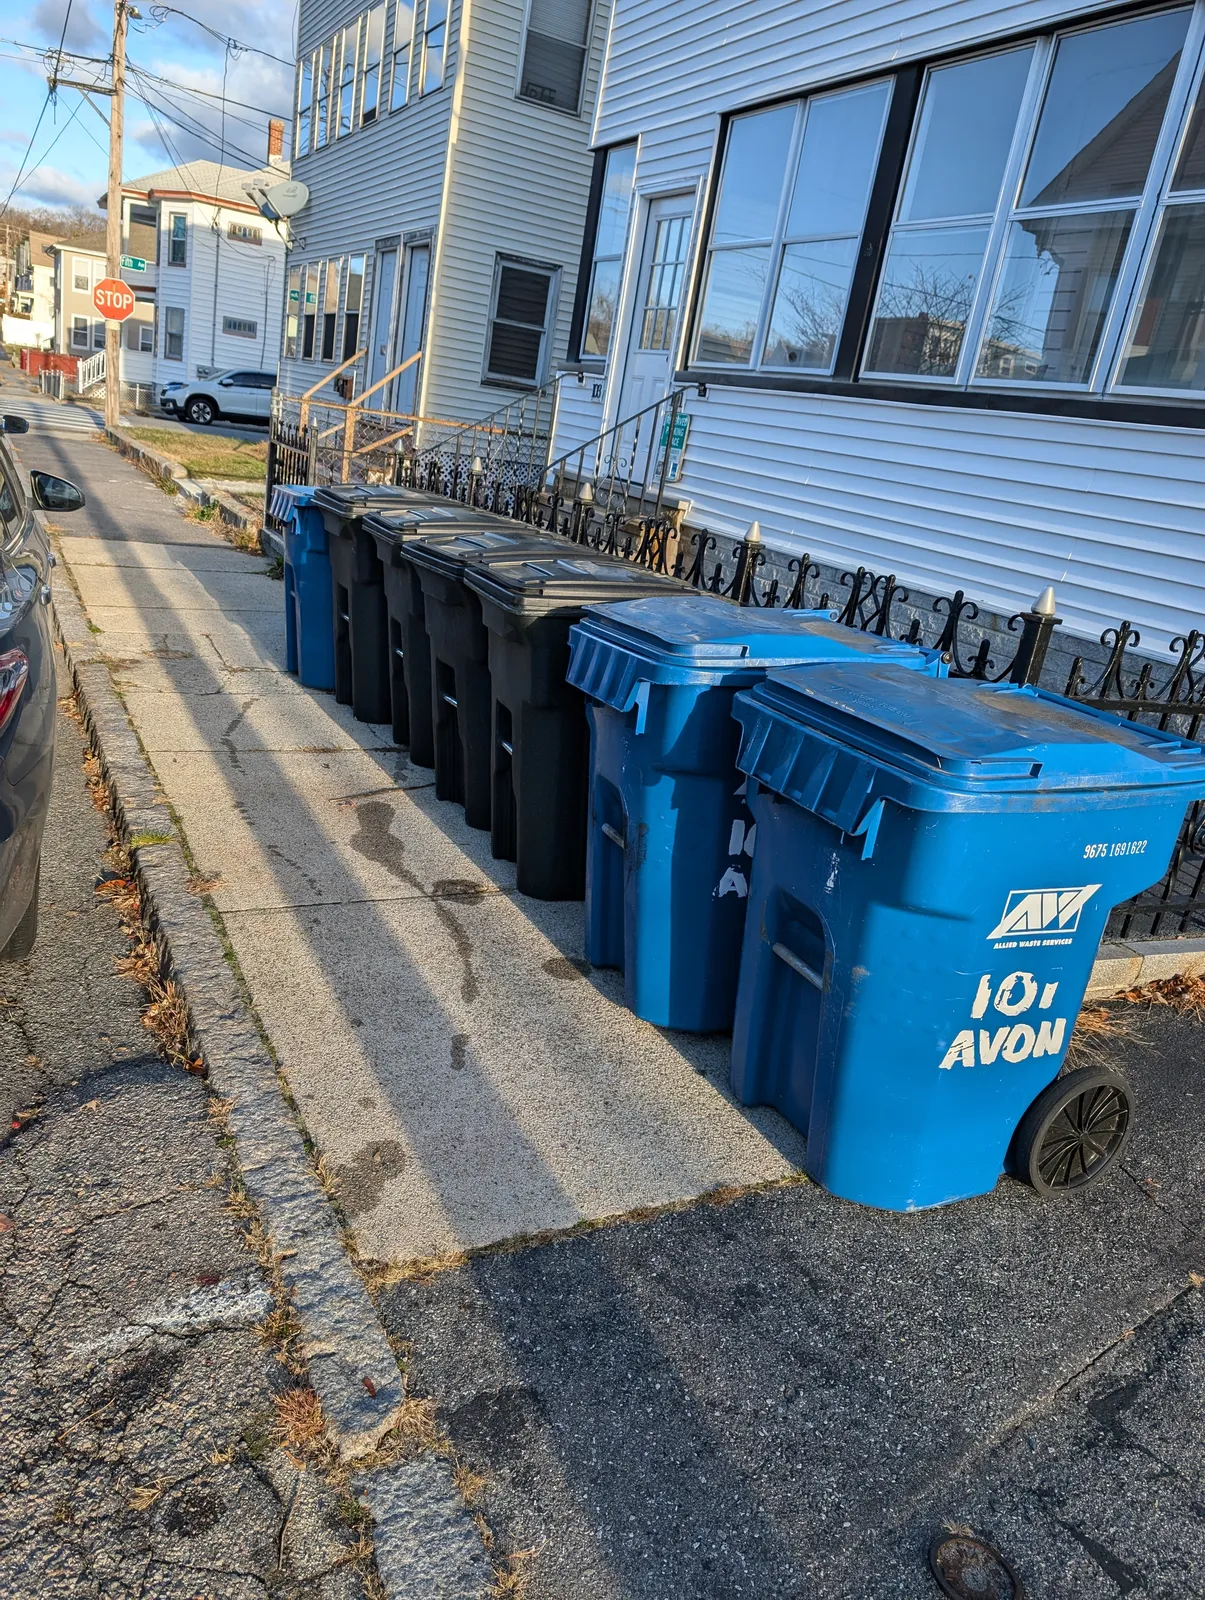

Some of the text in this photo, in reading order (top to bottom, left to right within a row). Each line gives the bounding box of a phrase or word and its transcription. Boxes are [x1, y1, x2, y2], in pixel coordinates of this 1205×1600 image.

[95, 289, 132, 310] STOP
[1083, 839, 1148, 859] 9675 1691622
[993, 938, 1073, 950] ALLIED WASTE SERVICES
[938, 1018, 1067, 1070] AVON
